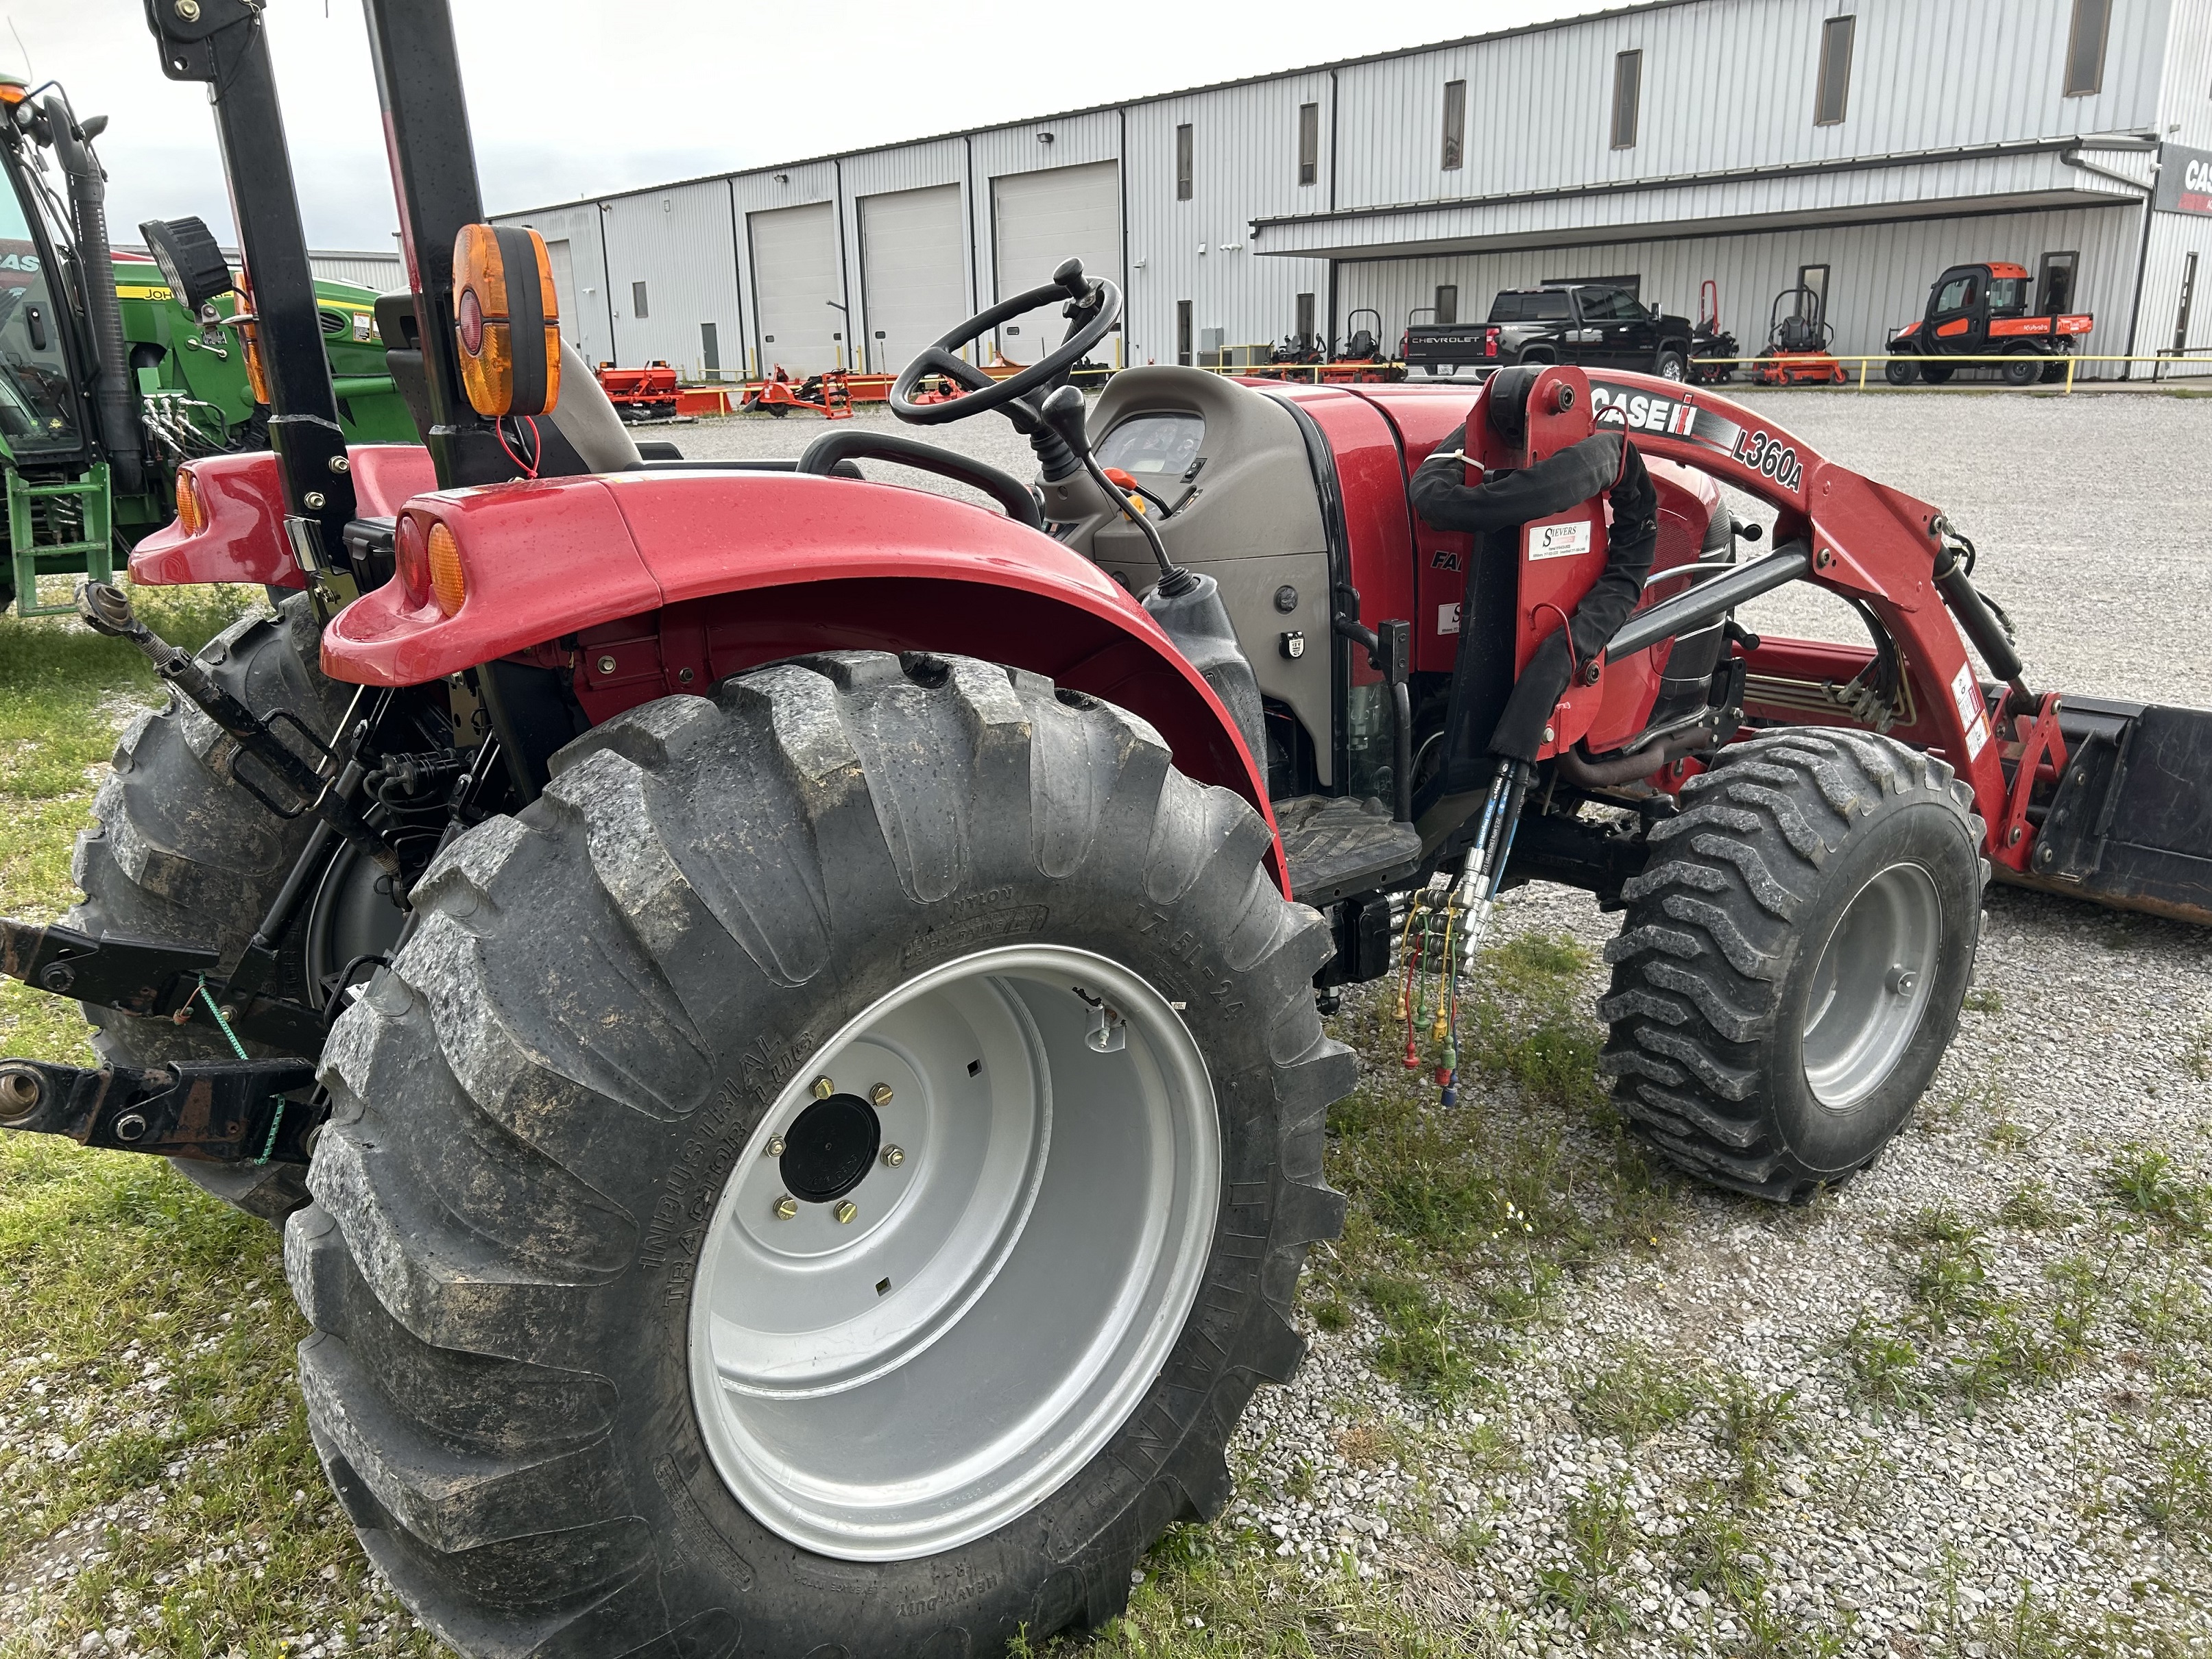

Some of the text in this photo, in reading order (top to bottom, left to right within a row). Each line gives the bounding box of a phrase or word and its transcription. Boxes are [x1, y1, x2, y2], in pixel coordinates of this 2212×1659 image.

[1591, 388, 1670, 431] CASE
[1731, 429, 1804, 494] L360A
[1542, 526, 1576, 548] SIEVERS
[952, 886, 1013, 914] NYLON
[638, 1034, 781, 1270] INDUSTRIAL
[663, 1119, 749, 1309] TRACTOR
